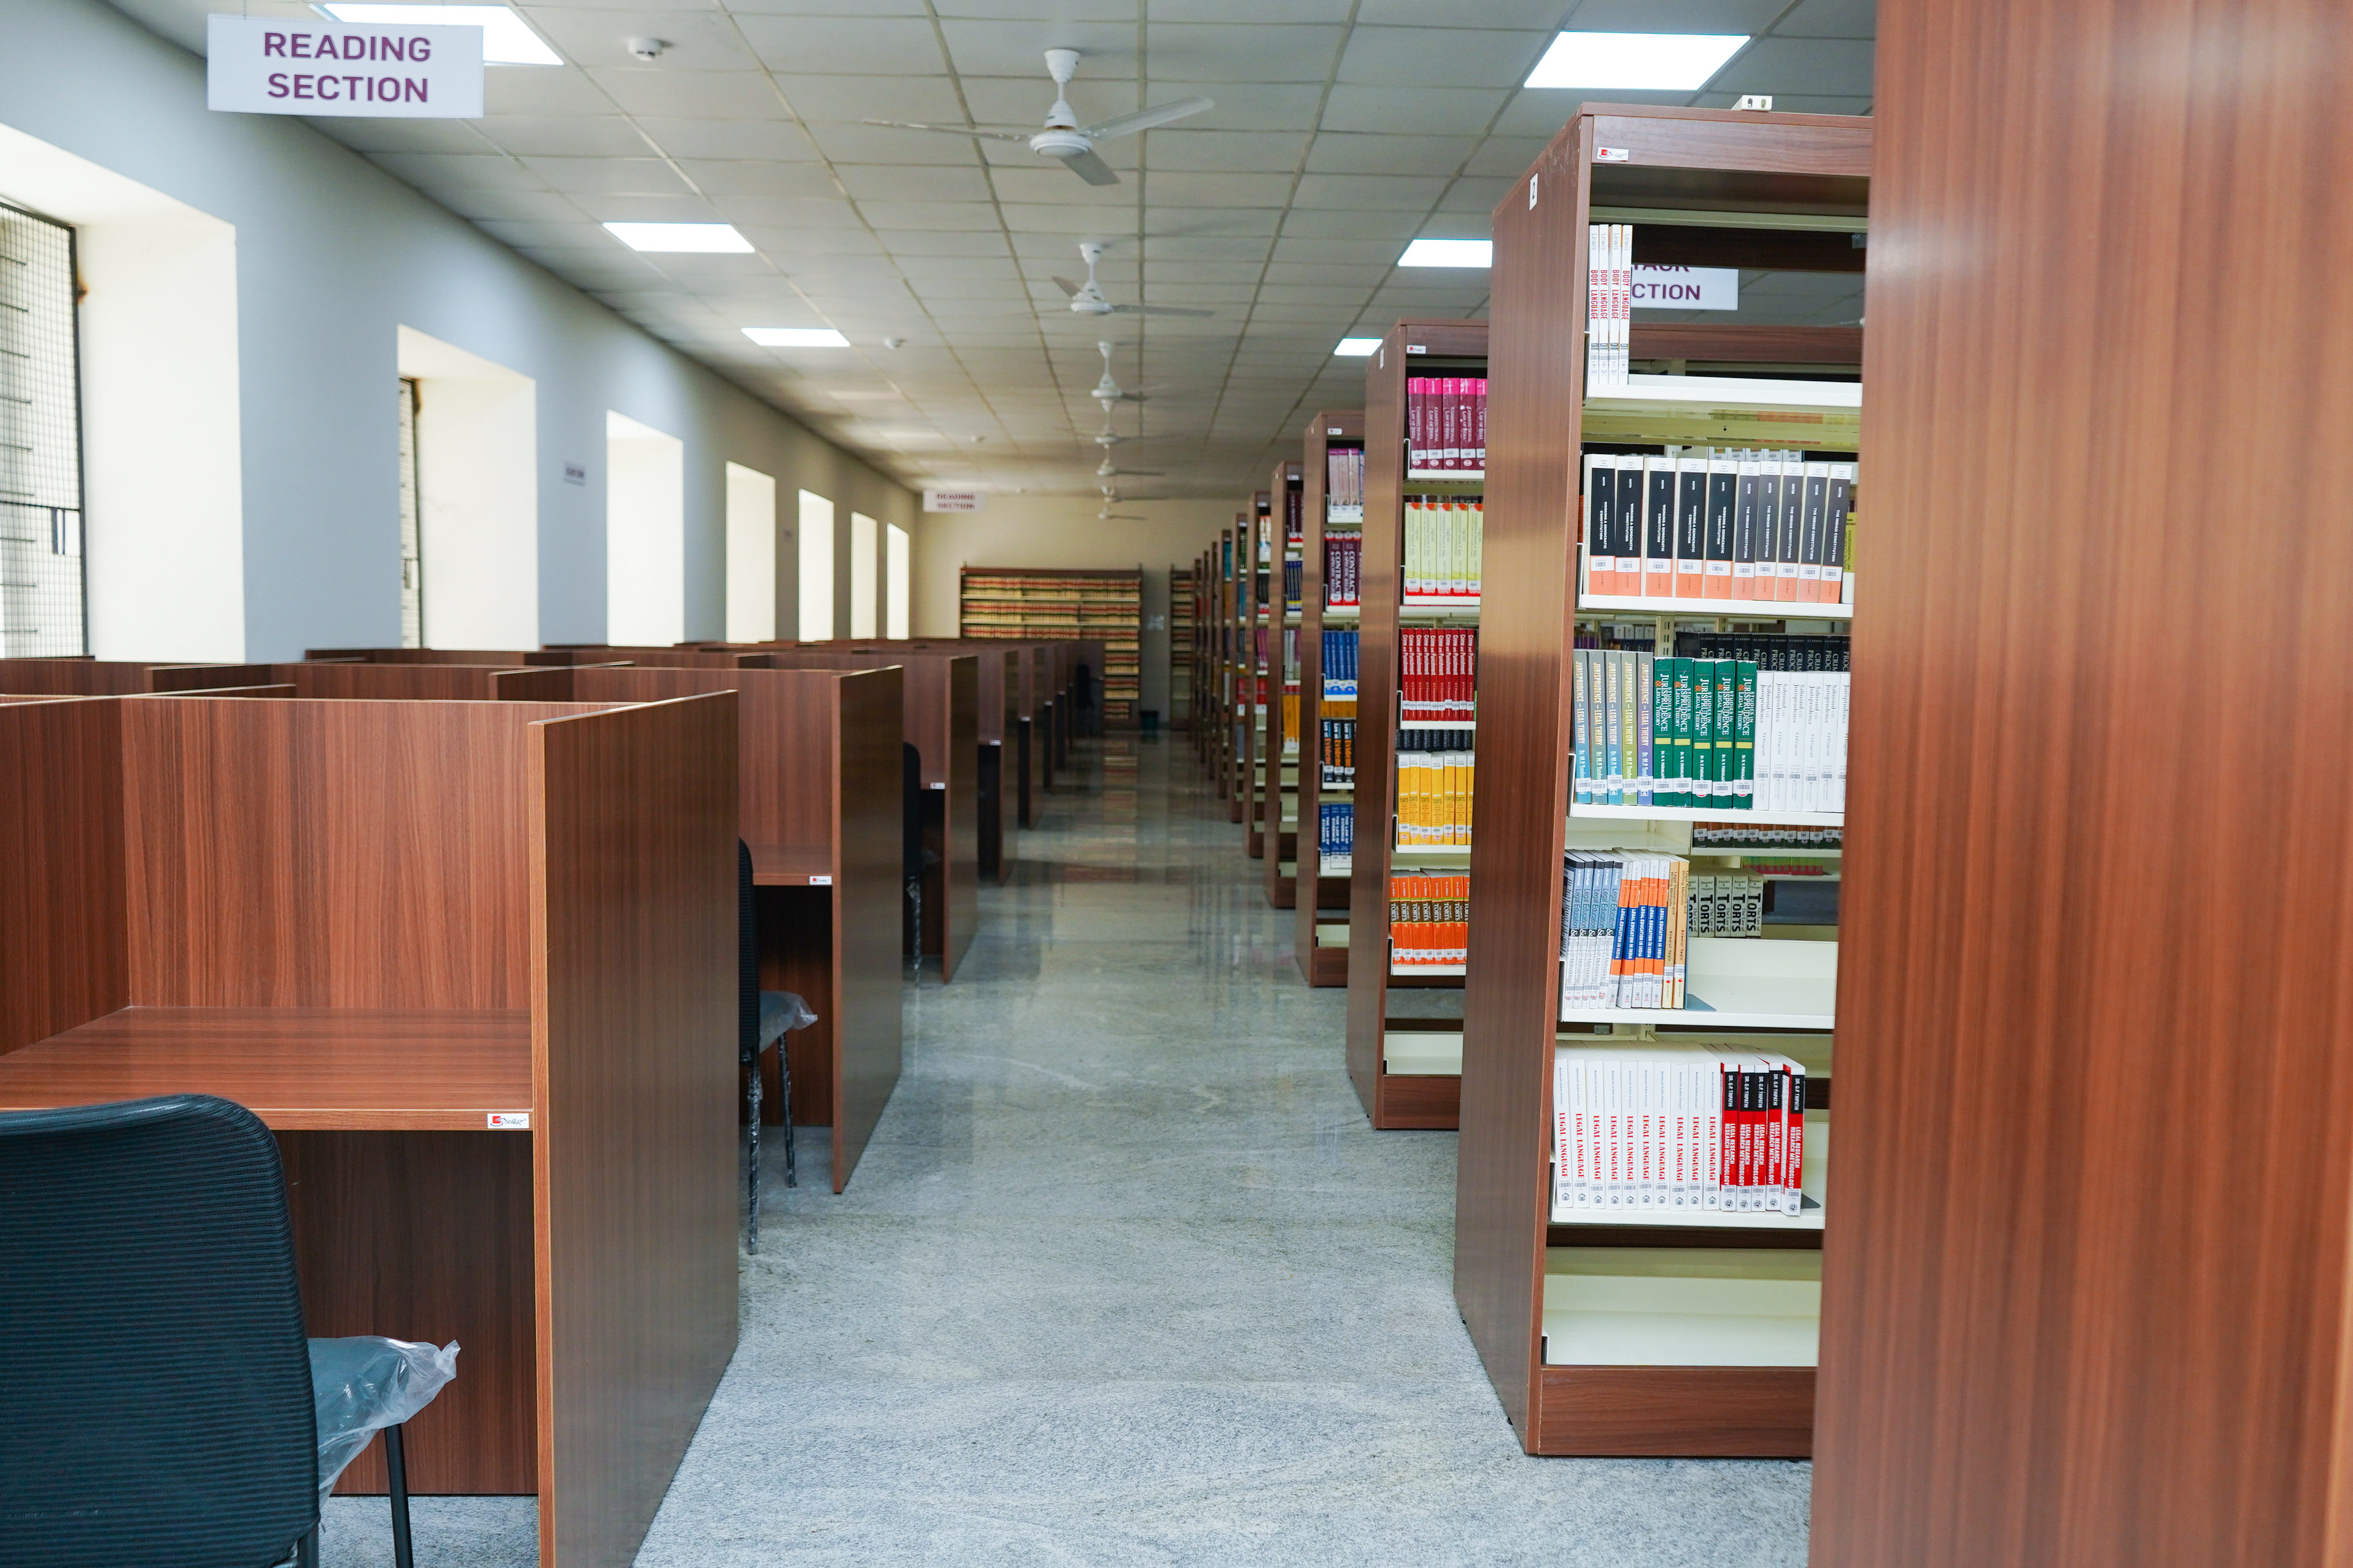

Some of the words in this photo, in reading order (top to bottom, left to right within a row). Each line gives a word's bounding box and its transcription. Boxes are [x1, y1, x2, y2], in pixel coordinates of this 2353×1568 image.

[265, 33, 431, 61] READING
[268, 73, 428, 102] SECTION
[1532, 182, 1535, 200] 2
[1632, 283, 1700, 300] CTION
[1575, 661, 1584, 702] JURISPRUDENCE
[1593, 663, 1602, 703] JURISPRUDENCE
[1660, 674, 1669, 732] JURISPRUDENCE
[1680, 674, 1688, 732] JURISPRUDENCE
[1722, 677, 1731, 735] JURISPRUDENCE
[1590, 904, 1599, 929] Education
[1700, 895, 1713, 933] TORTS
[1717, 894, 1729, 932] TORTS
[1732, 894, 1746, 932] TORTS
[1746, 893, 1761, 931] TORTS
[490, 1118, 524, 1127] Stellar
